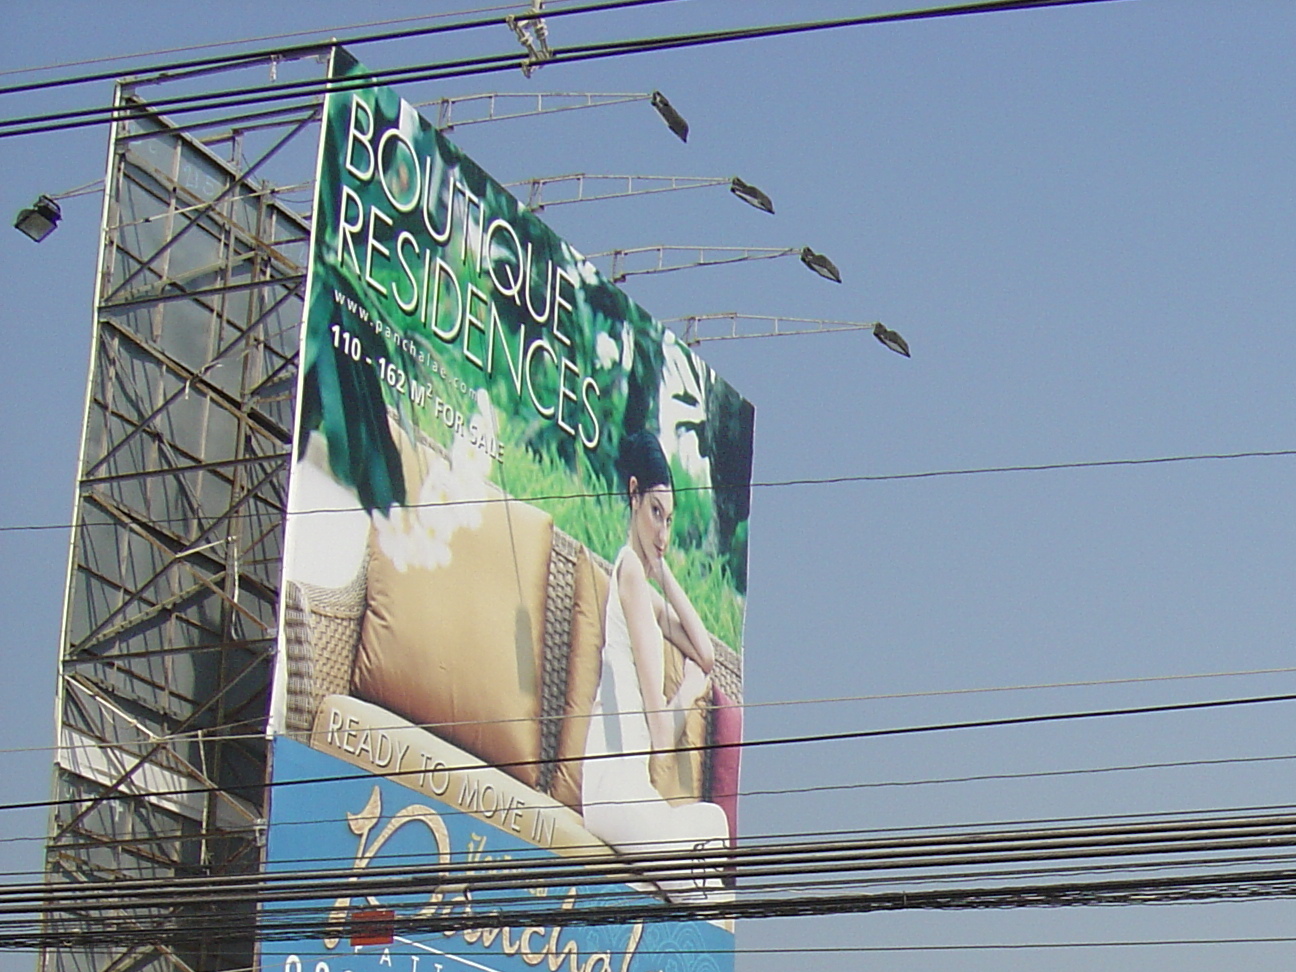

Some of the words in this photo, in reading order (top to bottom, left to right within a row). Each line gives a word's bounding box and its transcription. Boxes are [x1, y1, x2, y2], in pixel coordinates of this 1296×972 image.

[344, 93, 576, 347] BOUTIQUE
[334, 289, 478, 402] www.panchalae.com
[337, 184, 601, 449] RESIDENCES
[331, 324, 362, 362] 110
[378, 357, 406, 394] 162
[435, 396, 465, 438] FOR
[470, 424, 505, 464] SALE
[327, 707, 410, 773] READY
[419, 752, 451, 796] TO
[458, 773, 526, 833] MOVE
[531, 808, 557, 847] IN
